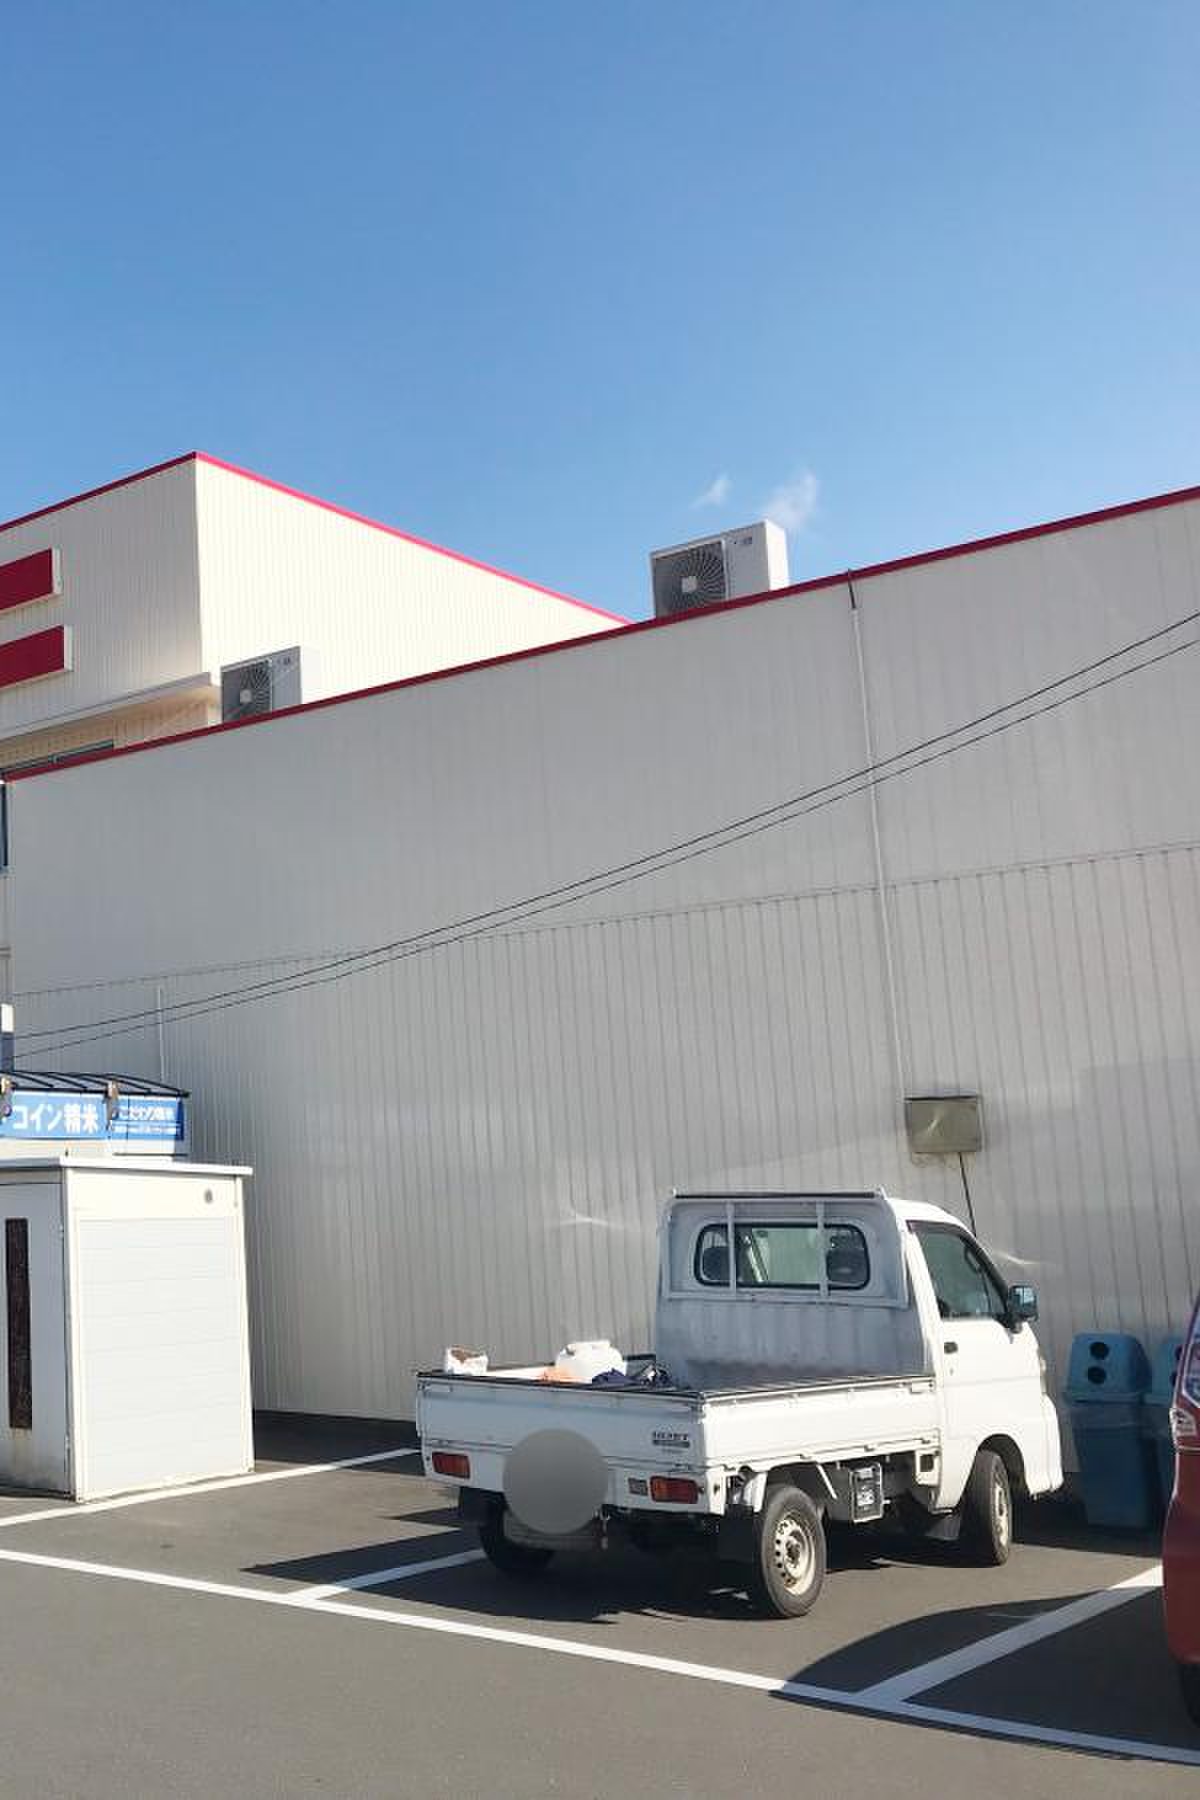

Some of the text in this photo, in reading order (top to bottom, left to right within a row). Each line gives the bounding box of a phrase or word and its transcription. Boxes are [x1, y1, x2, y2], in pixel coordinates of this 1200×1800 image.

[12, 1104, 98, 1134] コイン精米
